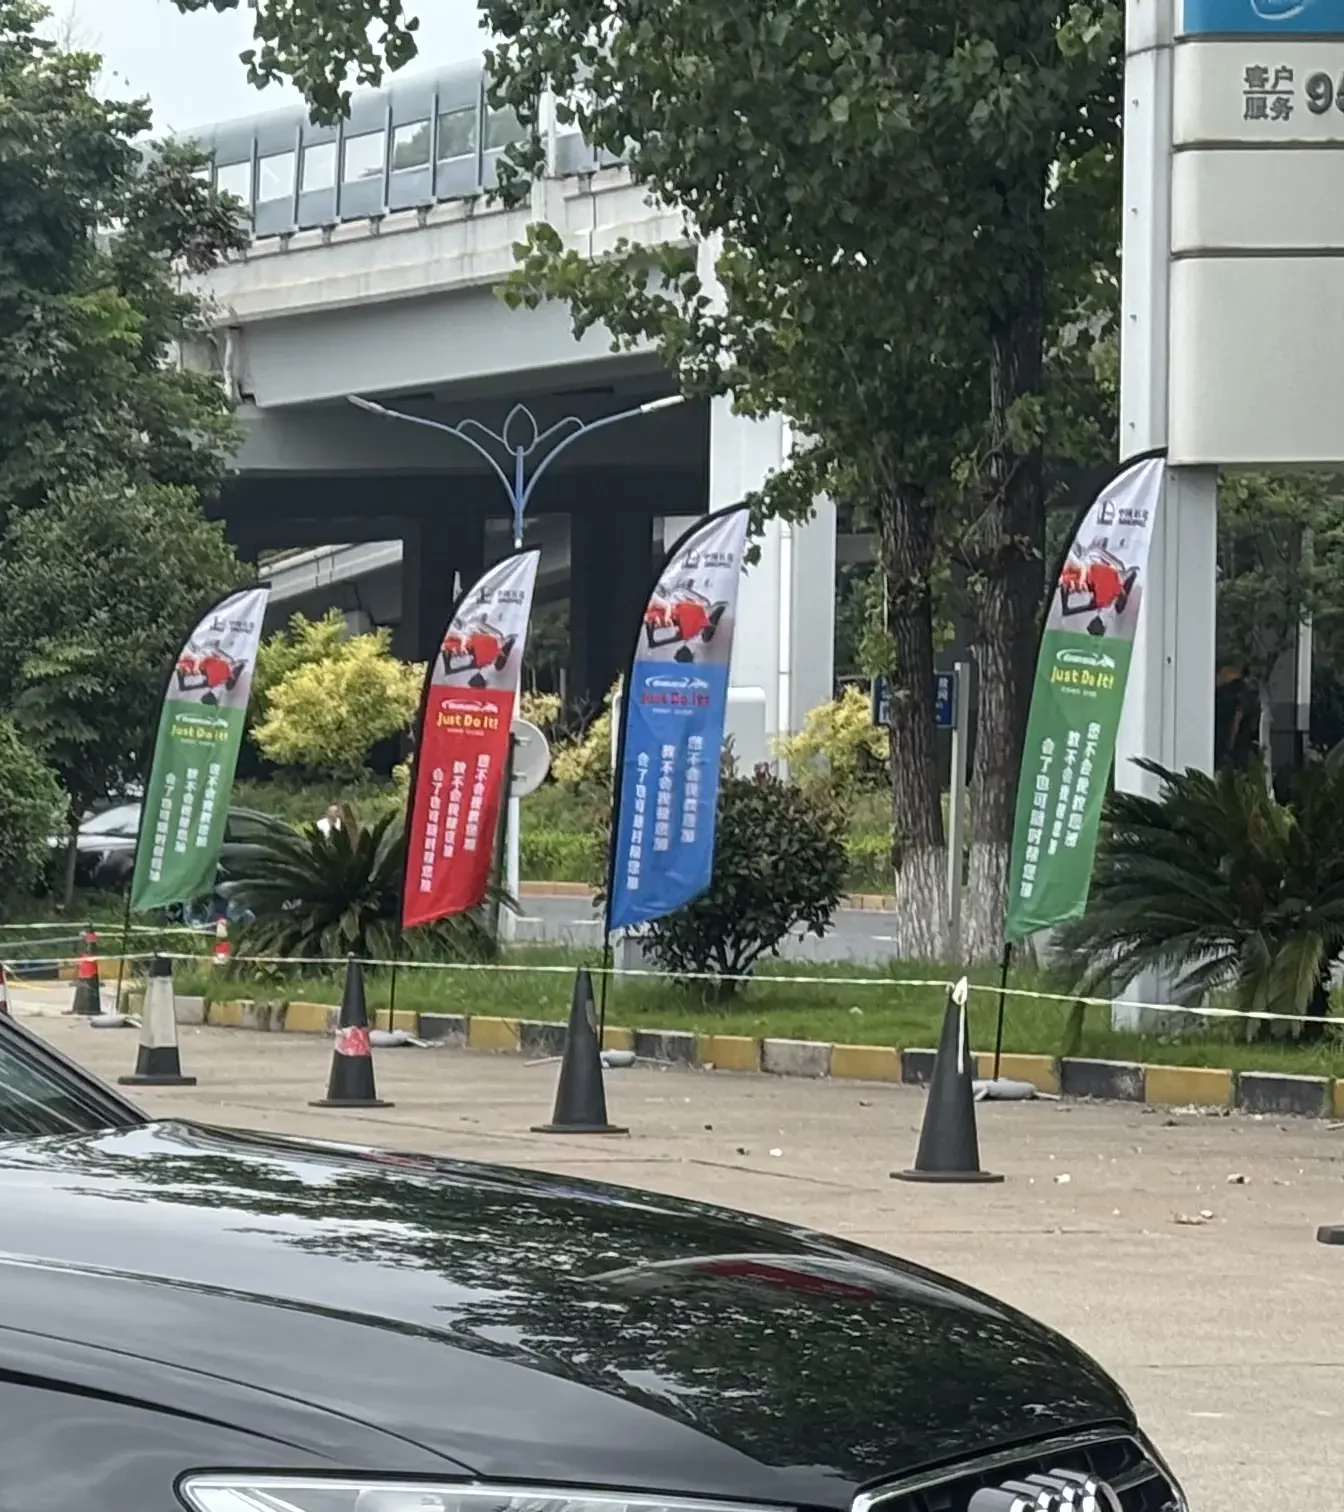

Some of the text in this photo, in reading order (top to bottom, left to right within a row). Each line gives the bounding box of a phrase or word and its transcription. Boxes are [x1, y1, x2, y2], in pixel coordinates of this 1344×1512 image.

[1243, 64, 1294, 90] 客户
[1243, 96, 1294, 121] 服务
[1051, 665, 1079, 684] Just
[1081, 669, 1095, 687] Do
[437, 712, 461, 727] Just
[464, 714, 481, 728] Do
